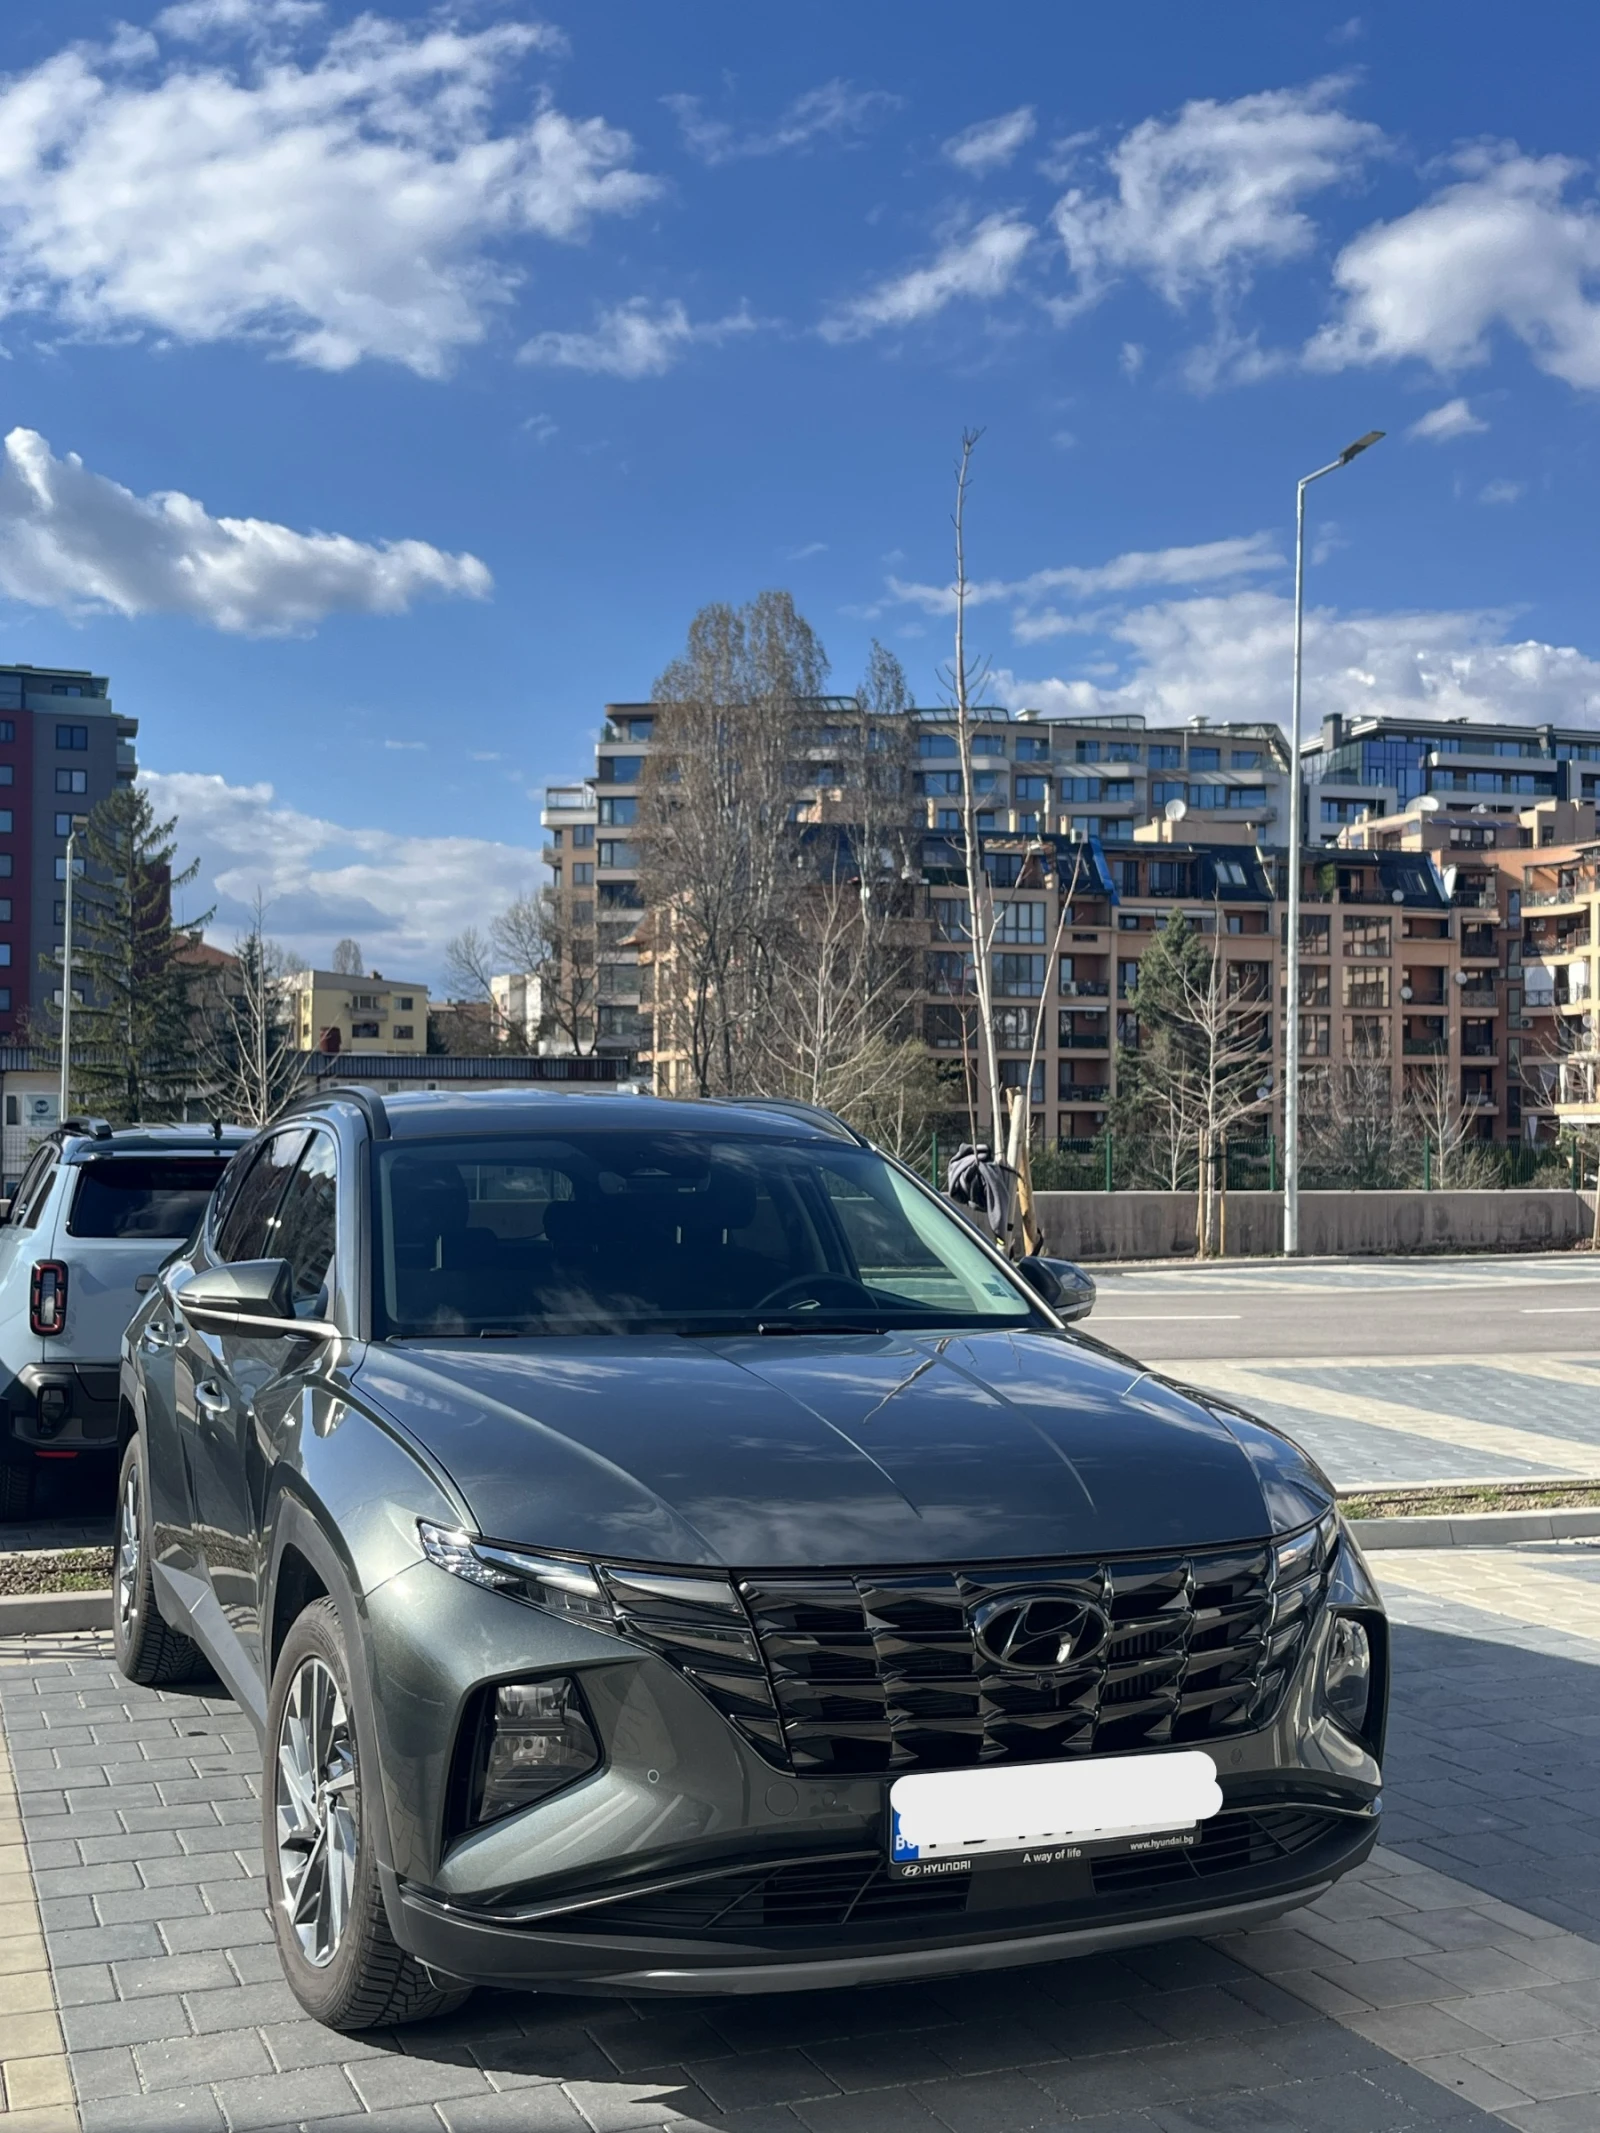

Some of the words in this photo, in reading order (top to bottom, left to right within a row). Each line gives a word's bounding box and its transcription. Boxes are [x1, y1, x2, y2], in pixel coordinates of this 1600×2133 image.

[1129, 1835, 1194, 1850] www.hyundai.bg
[1022, 1852, 1032, 1863] A
[1033, 1852, 1053, 1863] way
[1054, 1848, 1065, 1860] of
[1066, 1847, 1082, 1859] life
[923, 1860, 971, 1874] HYUNDAI
